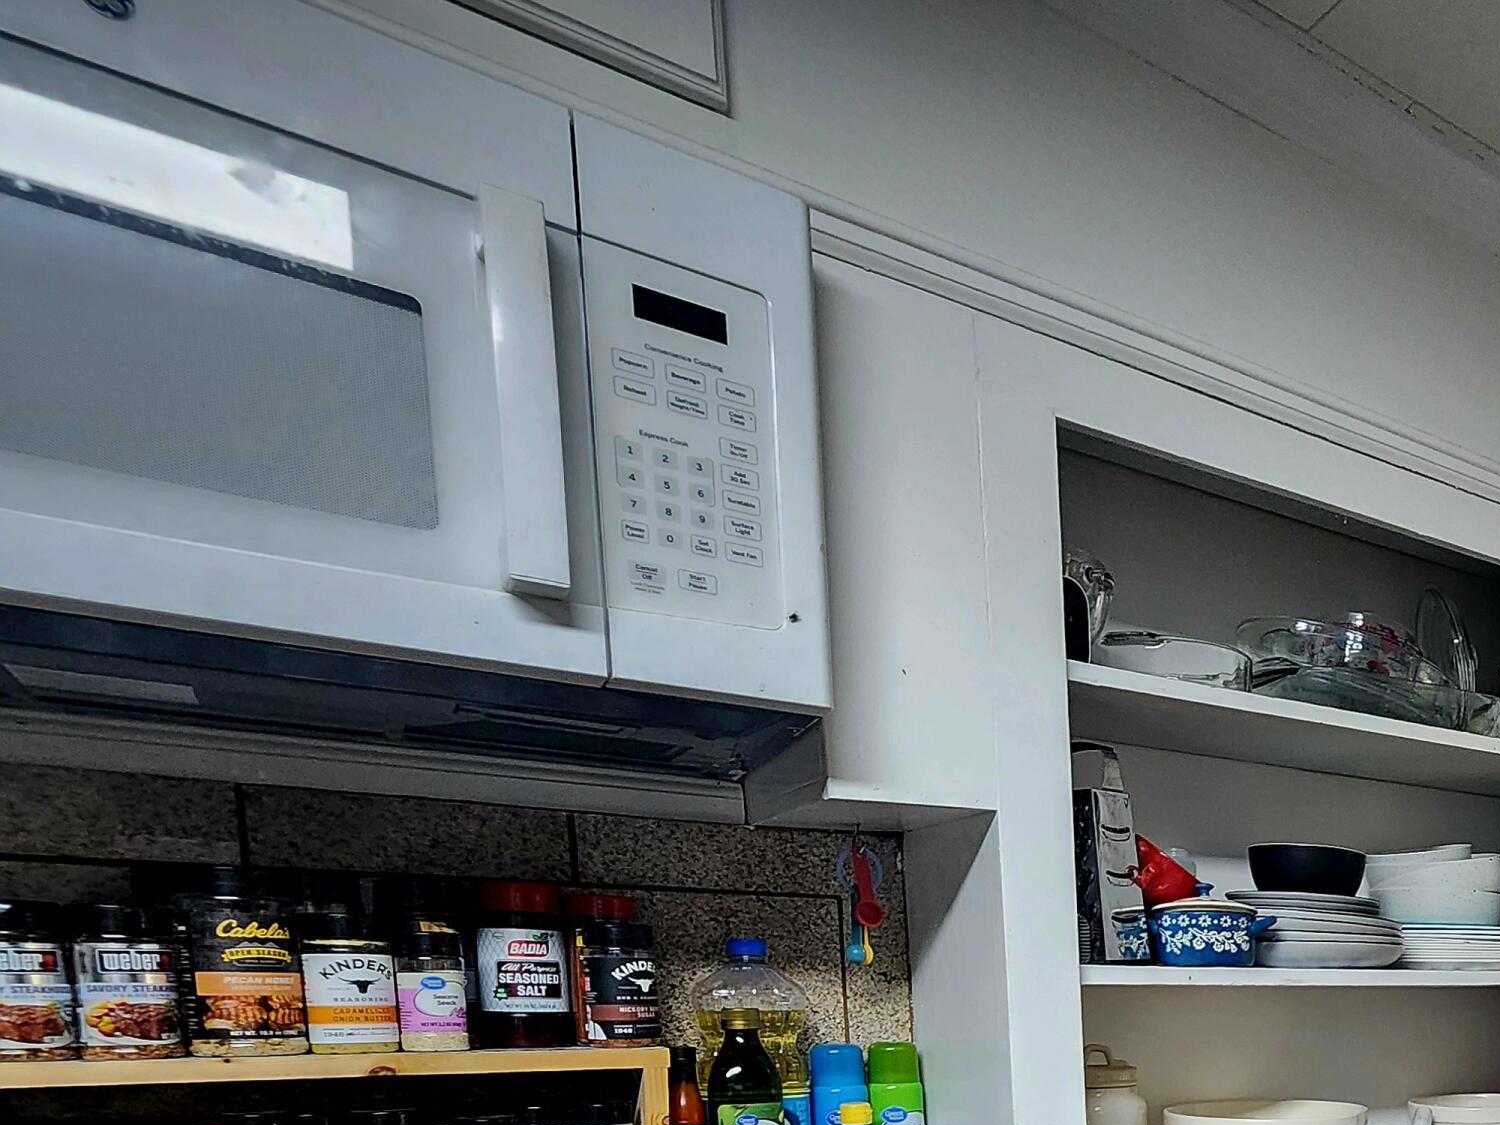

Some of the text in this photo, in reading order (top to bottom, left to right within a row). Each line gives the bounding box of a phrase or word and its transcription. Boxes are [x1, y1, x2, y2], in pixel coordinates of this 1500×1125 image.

[627, 446, 634, 455] 1
[661, 454, 670, 464] 2
[695, 462, 704, 472] 3
[628, 473, 637, 482] 4
[662, 481, 671, 490] 5
[697, 489, 705, 499] 6
[629, 499, 638, 508] 7
[664, 507, 673, 517] 8
[698, 514, 706, 524] 9
[215, 918, 291, 940] Cabela's
[229, 949, 253, 958] OPEN
[509, 942, 548, 956] BADIA
[102, 950, 160, 971] weber
[500, 962, 520, 972] All
[610, 960, 657, 981] KINDE
[498, 972, 560, 985] SEASONED
[86, 984, 127, 994] SAVORY
[516, 985, 548, 997] SALT
